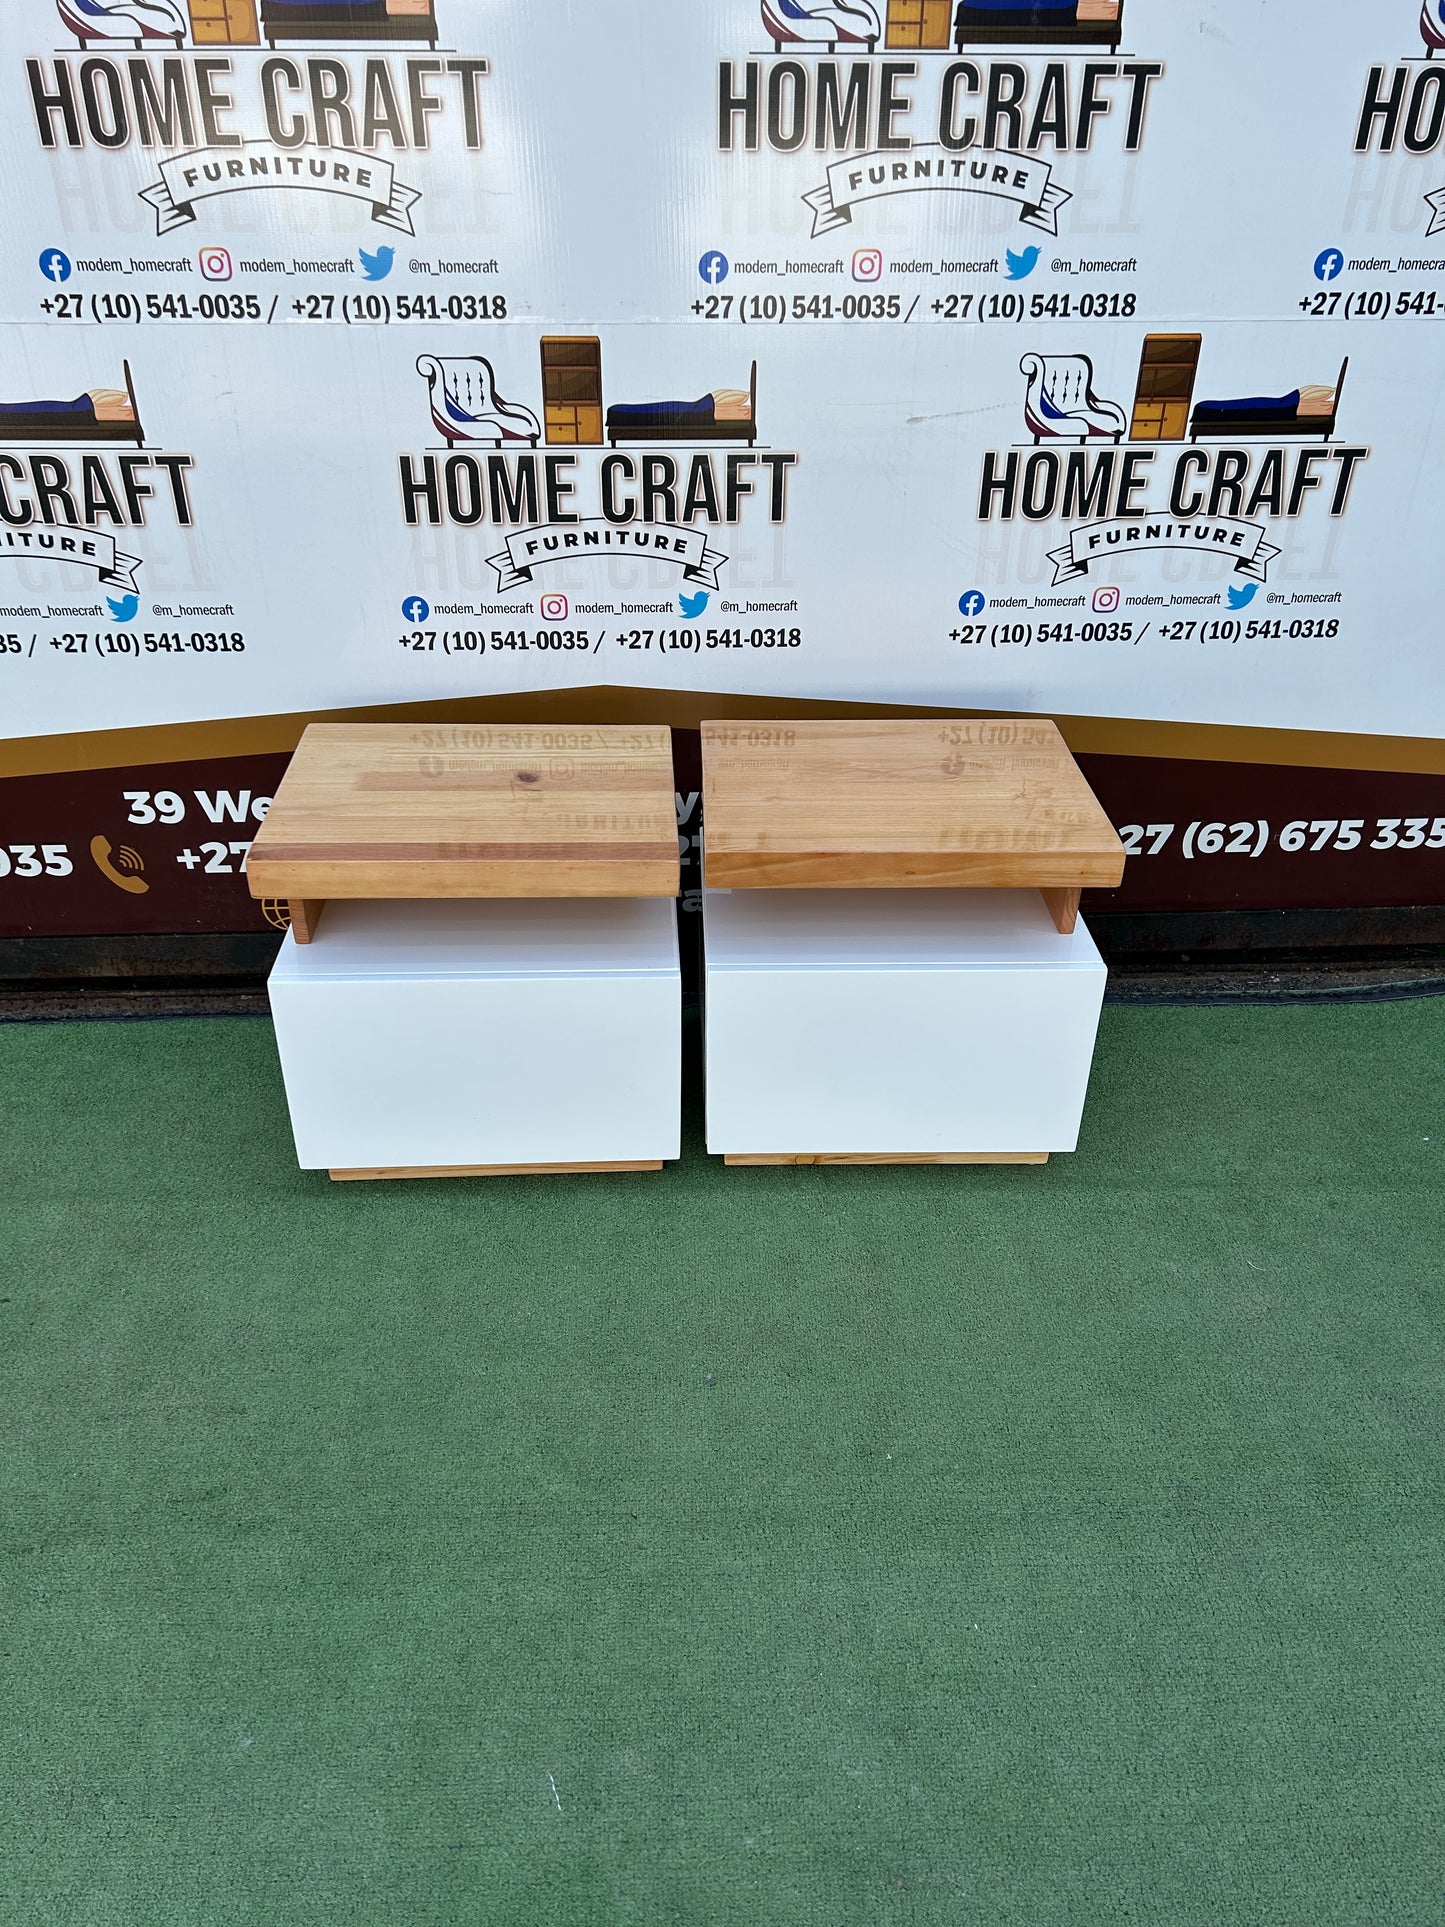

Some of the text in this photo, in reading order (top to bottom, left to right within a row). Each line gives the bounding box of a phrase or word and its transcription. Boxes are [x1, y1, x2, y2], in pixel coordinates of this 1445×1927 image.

[25, 58, 489, 149] HOME CRAFT
[720, 62, 1161, 149] HOME CRAFT
[183, 156, 374, 189] FURNITURE
[848, 158, 1030, 190] FURNITURE
[409, 259, 498, 275] @m_homecraft
[1051, 258, 1137, 274] @m_homecraft
[40, 294, 506, 324] +27 (10) 541-0035 / +27 (10) 541-0318
[691, 294, 1136, 323] +27 (10) 541-0035 / +27 (10) 541-0318
[1299, 292, 1445, 320] +27 (10) 541-
[0, 456, 190, 524] CRAFT
[400, 455, 795, 523] HOME CRAFT
[979, 449, 1367, 518] HOME CRAFT
[0, 531, 96, 557] ITURE
[525, 530, 689, 556] FURNITURE
[1087, 523, 1247, 550] FURNITURE
[153, 604, 234, 617] @m_homecraft
[721, 600, 797, 613] @m_homecraft
[1267, 592, 1342, 605] @m_homecraft
[28, 634, 36, 657] /
[50, 634, 87, 652] +27
[96, 634, 139, 657] (10)
[144, 633, 245, 652] 541-0318
[399, 628, 801, 654] +27 (10) 541-0035 / +27 (10) 541-0318
[949, 619, 1339, 647] +27 (10) 541-0035 / +27 (10) 541-0318
[123, 791, 185, 824] 39
[1183, 820, 1269, 858] (62)
[1280, 820, 1364, 851] 675
